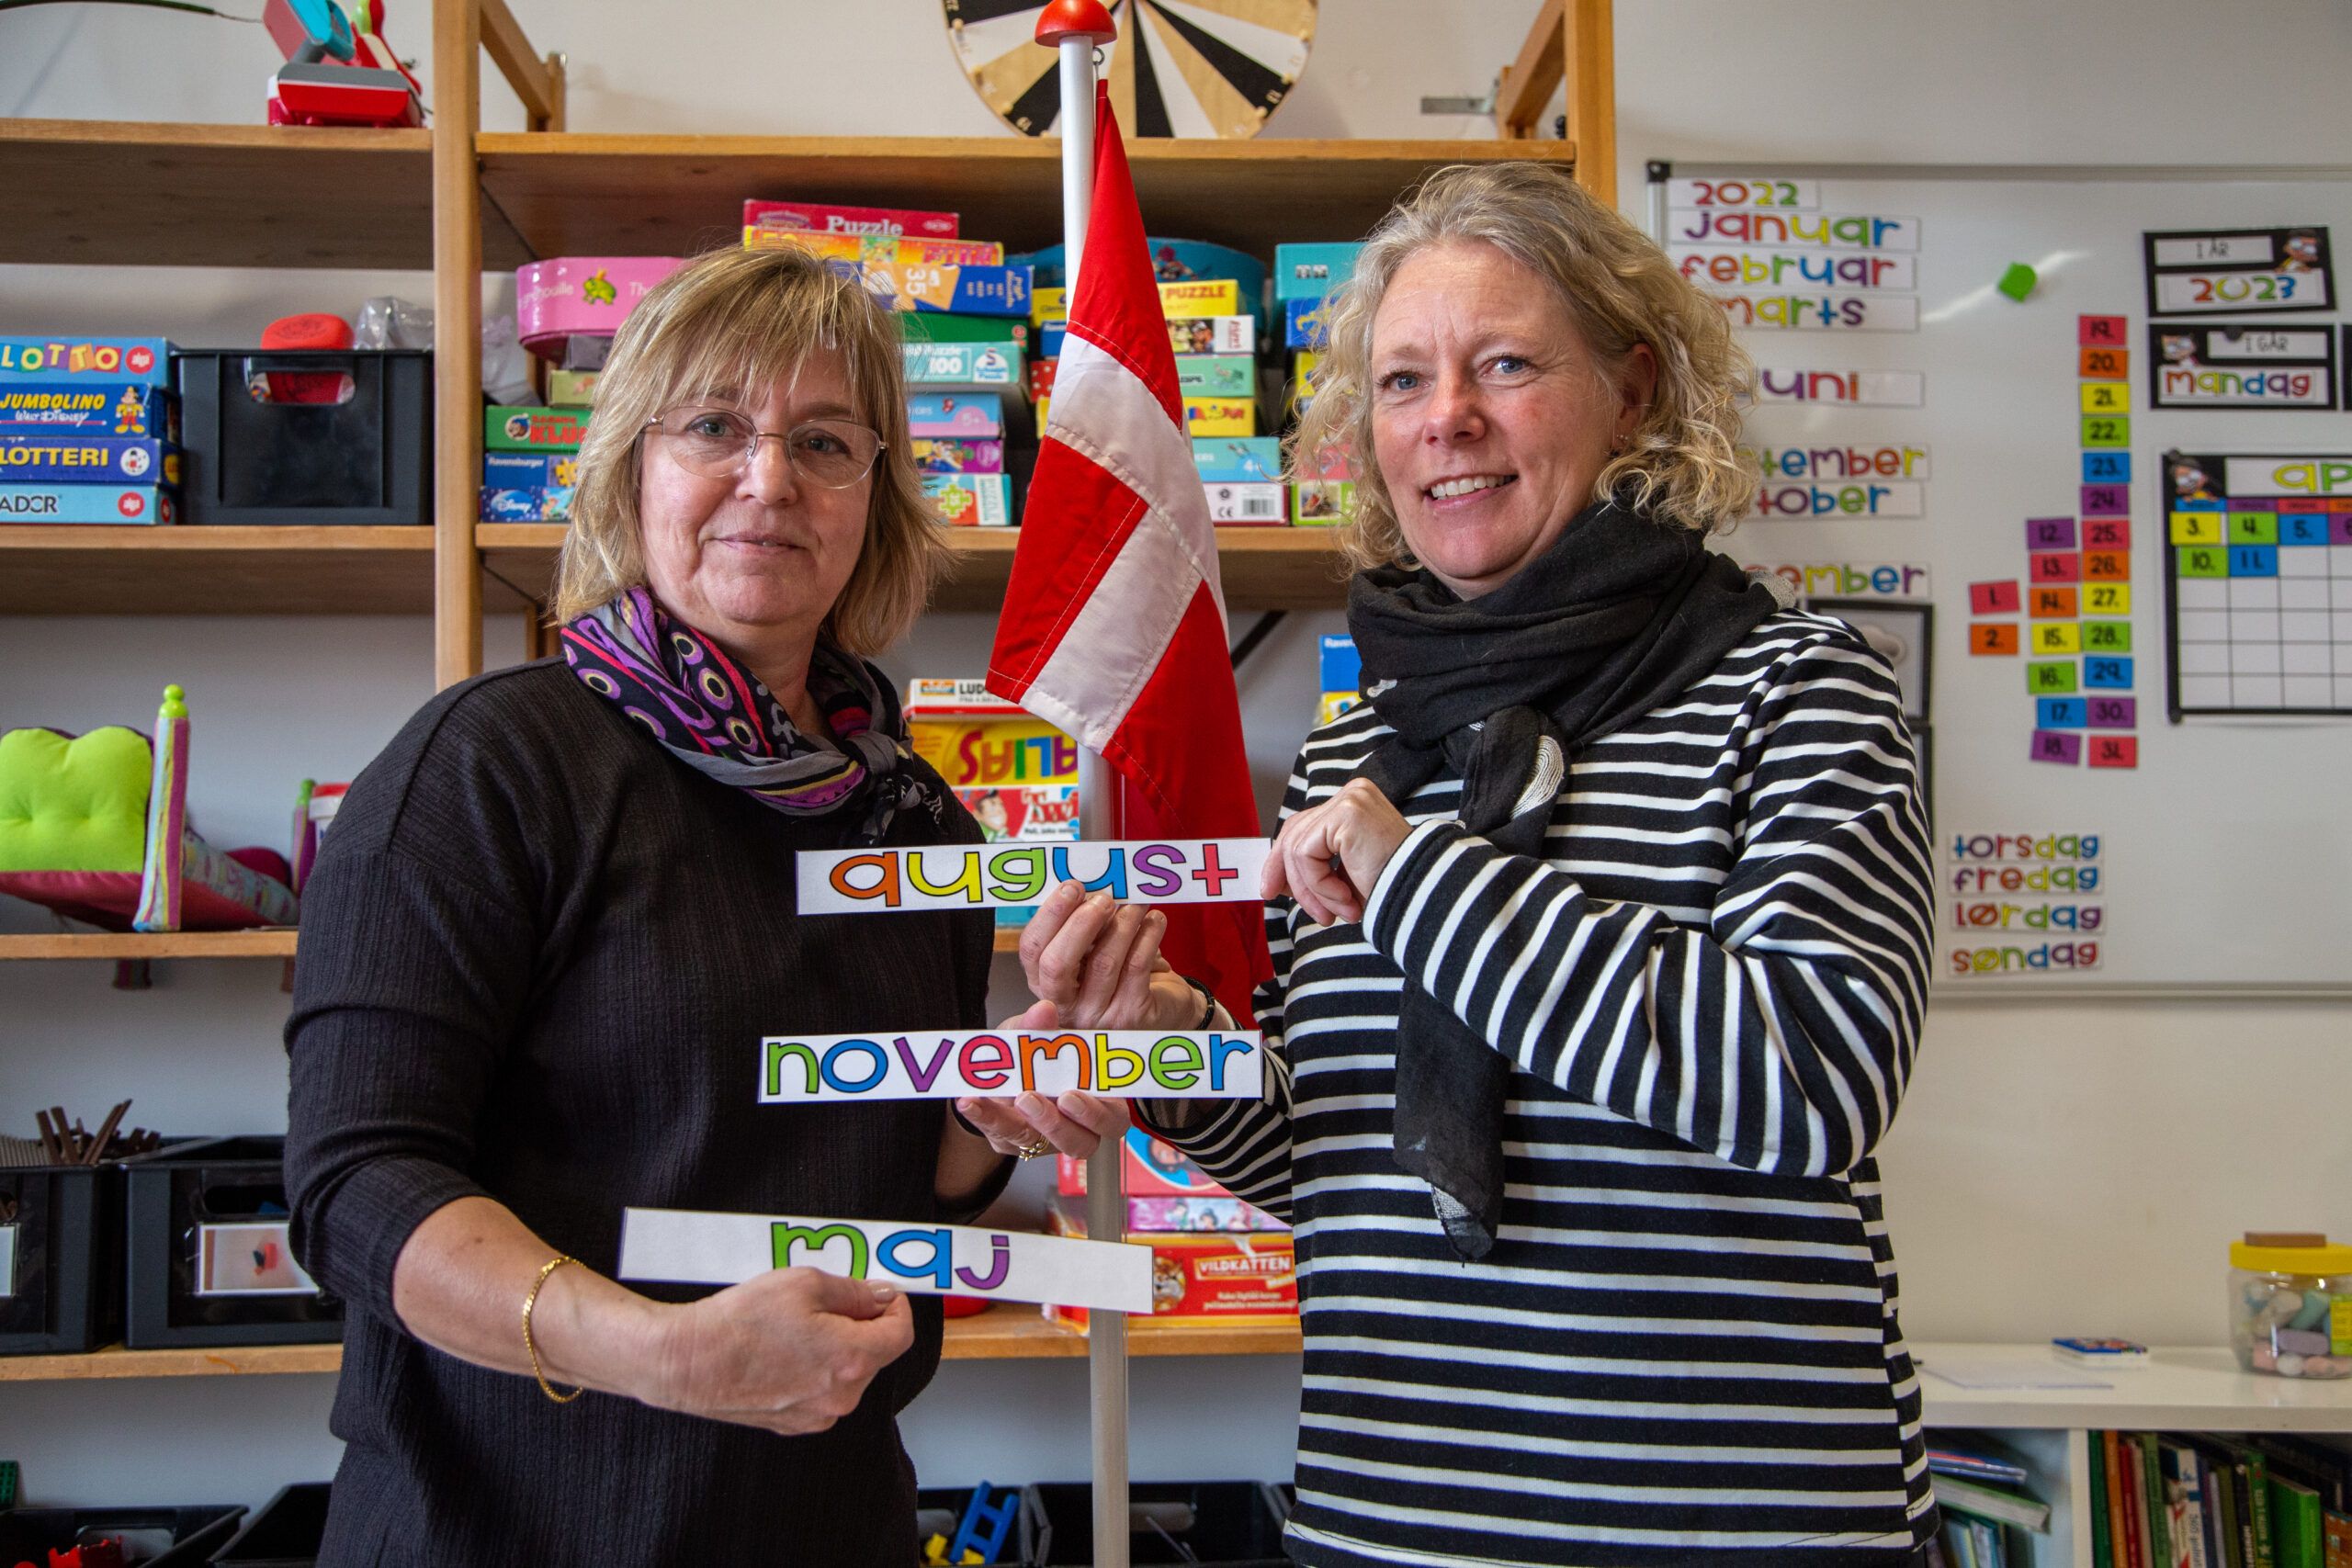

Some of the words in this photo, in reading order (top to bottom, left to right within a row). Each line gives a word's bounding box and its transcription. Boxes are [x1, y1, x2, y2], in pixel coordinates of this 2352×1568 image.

[1692, 182, 1799, 206] 2022
[827, 215, 903, 236] Puzzle
[1684, 212, 1901, 248] januar
[1681, 254, 1895, 287] februar
[1166, 285, 1226, 299] PUZZLE
[2189, 276, 2296, 303] 2023
[1, 343, 120, 370] LOTTO
[1761, 370, 1859, 401] uni
[2165, 370, 2311, 397] mandag
[0, 393, 107, 410] JUMBOLINO
[0, 447, 108, 466] LOTTERI
[1757, 446, 1925, 478] tember
[0, 496, 58, 513] ADOR
[1755, 484, 1891, 515] tober
[1748, 563, 1925, 595] ember
[959, 682, 986, 695] LUD
[958, 730, 1079, 784] ALIAS
[1954, 834, 2099, 859] torsdag
[829, 843, 1238, 907] august
[1954, 866, 2098, 892] fredag
[1956, 903, 2102, 931] lørdag
[1951, 942, 2098, 973] søndag
[766, 1033, 1251, 1095] november
[770, 1222, 1010, 1290] maj
[1200, 1258, 1291, 1272] VILDKATTEN
